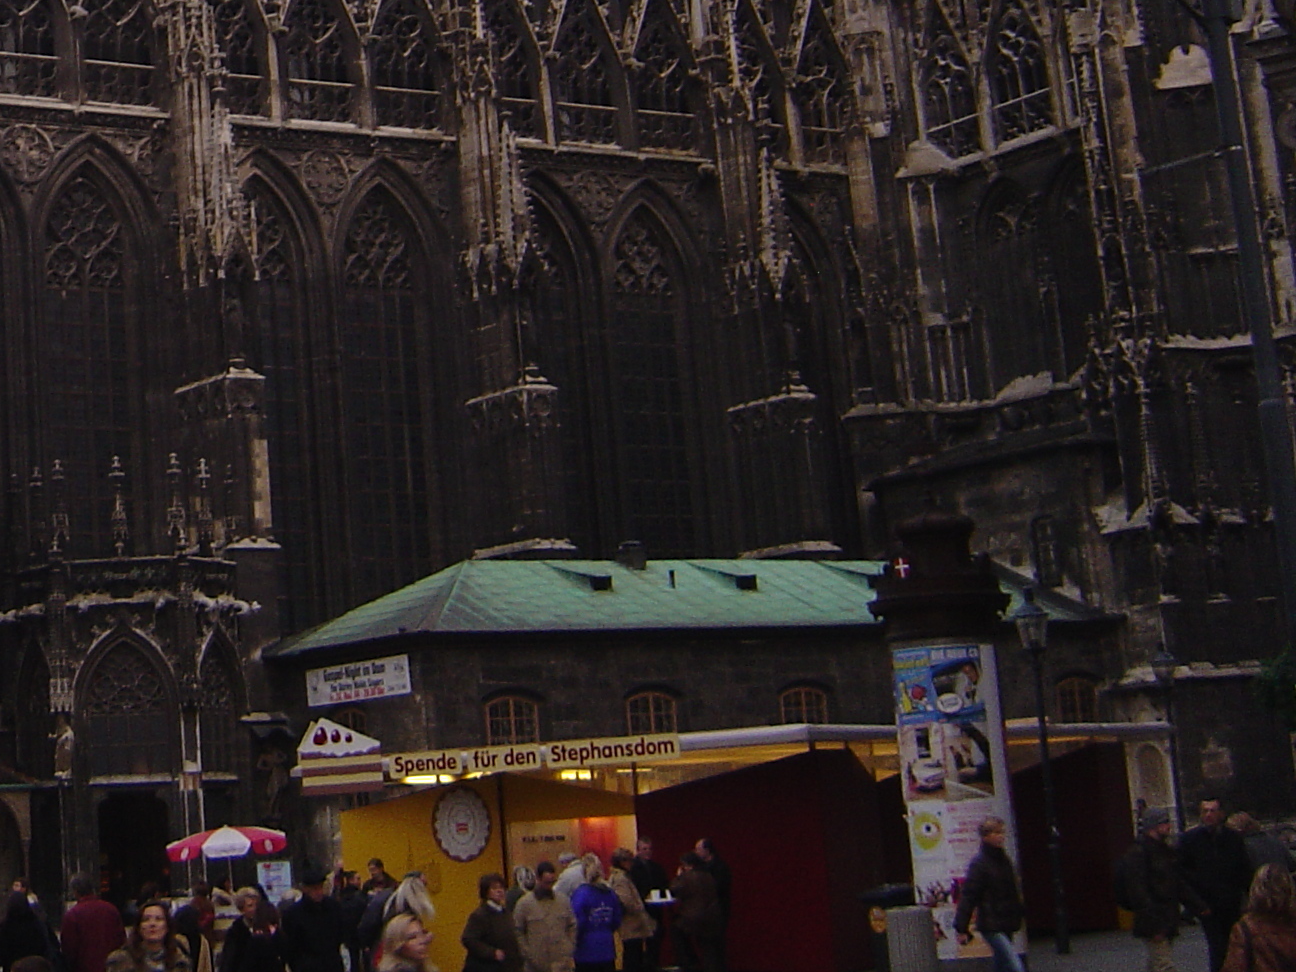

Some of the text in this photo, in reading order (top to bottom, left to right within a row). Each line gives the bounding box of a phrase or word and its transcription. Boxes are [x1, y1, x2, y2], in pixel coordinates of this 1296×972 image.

[394, 737, 675, 776] Spende für den Stephansdom
